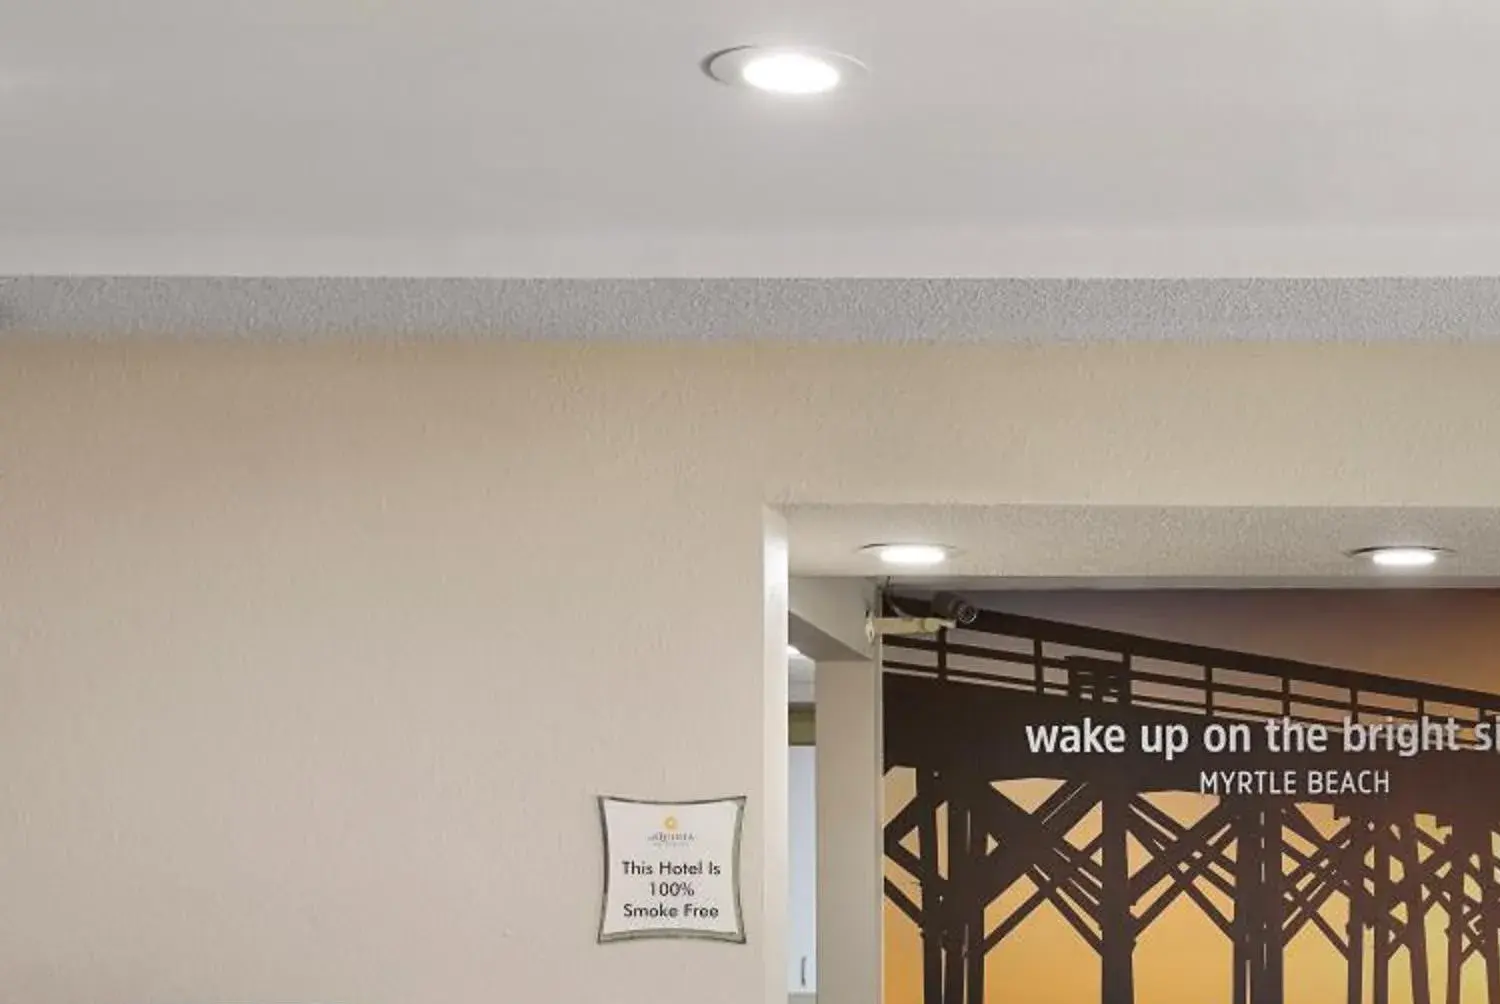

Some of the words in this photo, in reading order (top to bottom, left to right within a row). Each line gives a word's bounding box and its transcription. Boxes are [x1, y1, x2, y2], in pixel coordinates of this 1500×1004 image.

[1026, 718, 1125, 753] wake
[1141, 723, 1188, 760] up
[1204, 723, 1251, 753] on
[1267, 716, 1328, 752] the
[1344, 715, 1459, 758] bright
[1201, 770, 1297, 794] MYRTLE
[1307, 770, 1389, 794] BEACH
[622, 860, 653, 875] This
[659, 860, 703, 875] Hotel
[708, 861, 721, 875] Is
[650, 881, 695, 897] 100%
[623, 903, 678, 918] Smoke
[684, 903, 719, 918] Free
